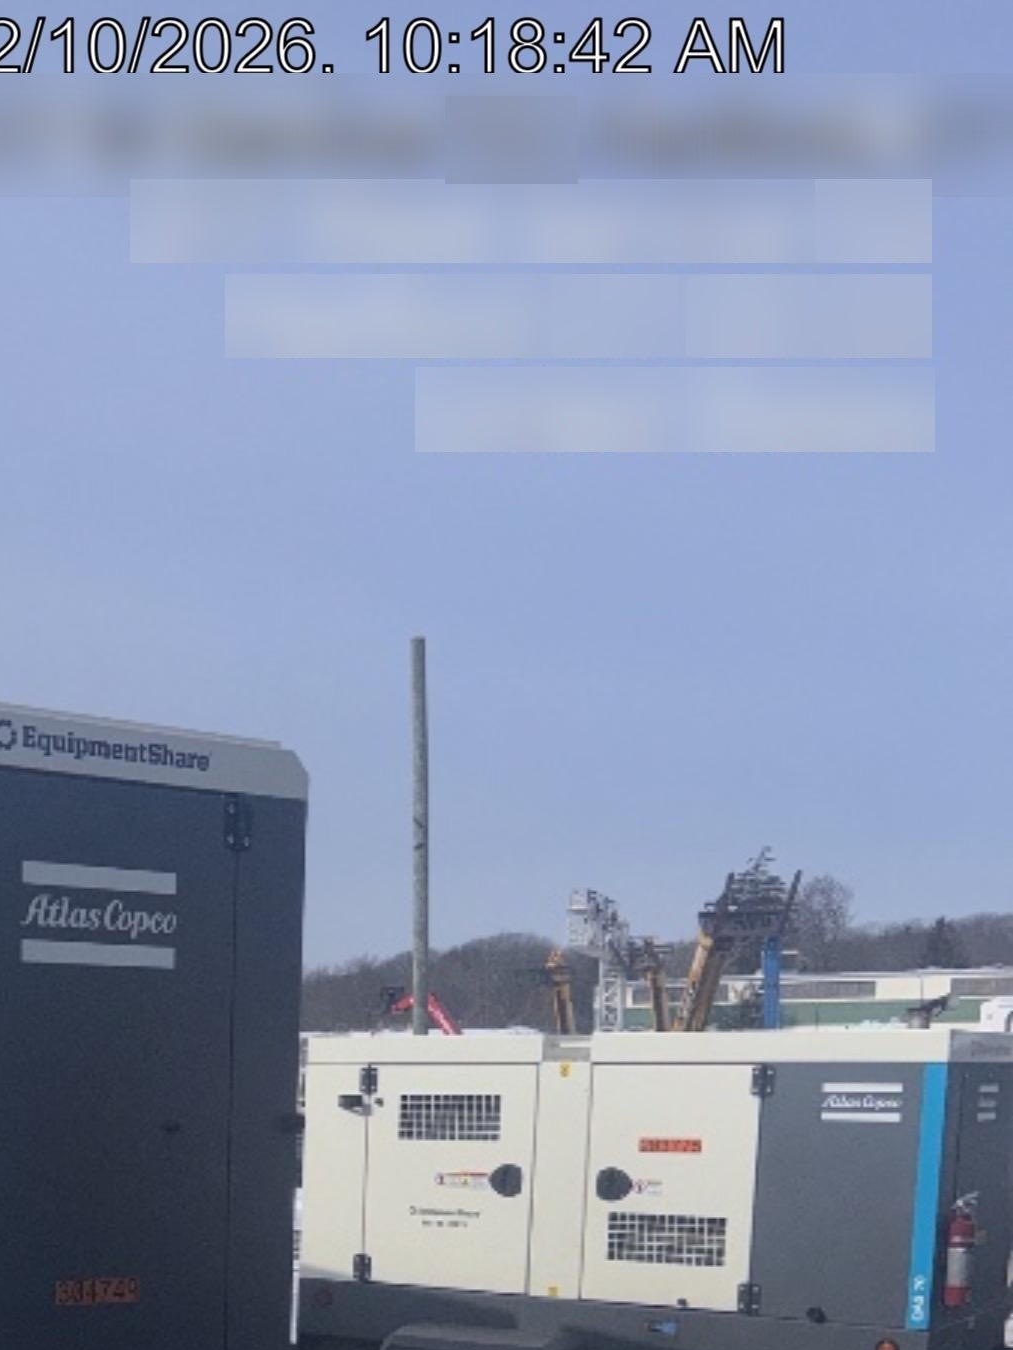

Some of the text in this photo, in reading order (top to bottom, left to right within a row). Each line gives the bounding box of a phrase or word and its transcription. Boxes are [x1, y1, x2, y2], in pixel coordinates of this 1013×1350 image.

[22, 725, 210, 771] EquipmentShare
[20, 894, 178, 939] Atlas Copco
